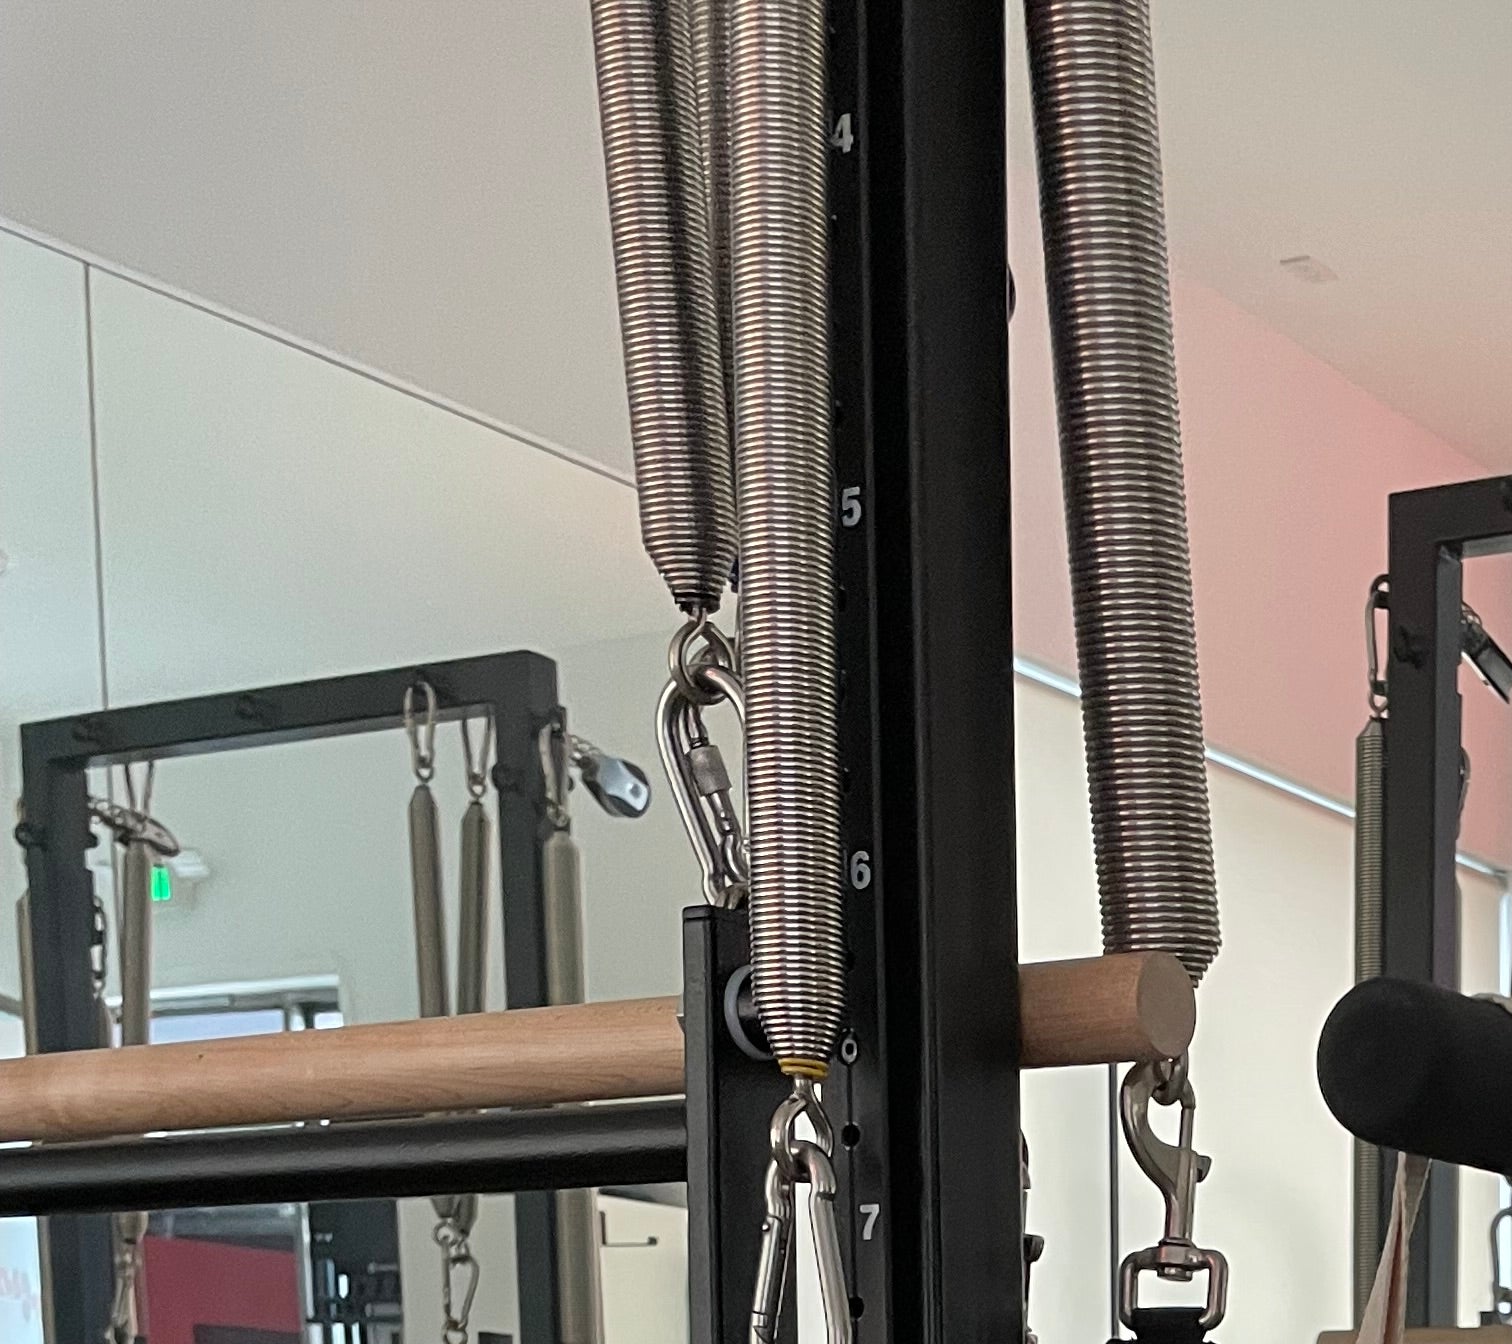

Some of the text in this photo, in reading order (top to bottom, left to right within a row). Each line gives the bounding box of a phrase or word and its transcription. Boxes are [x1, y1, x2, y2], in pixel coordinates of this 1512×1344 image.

[830, 112, 854, 154] 4
[841, 486, 862, 527] 5
[850, 850, 871, 890] 6
[859, 1203, 880, 1241] 7
